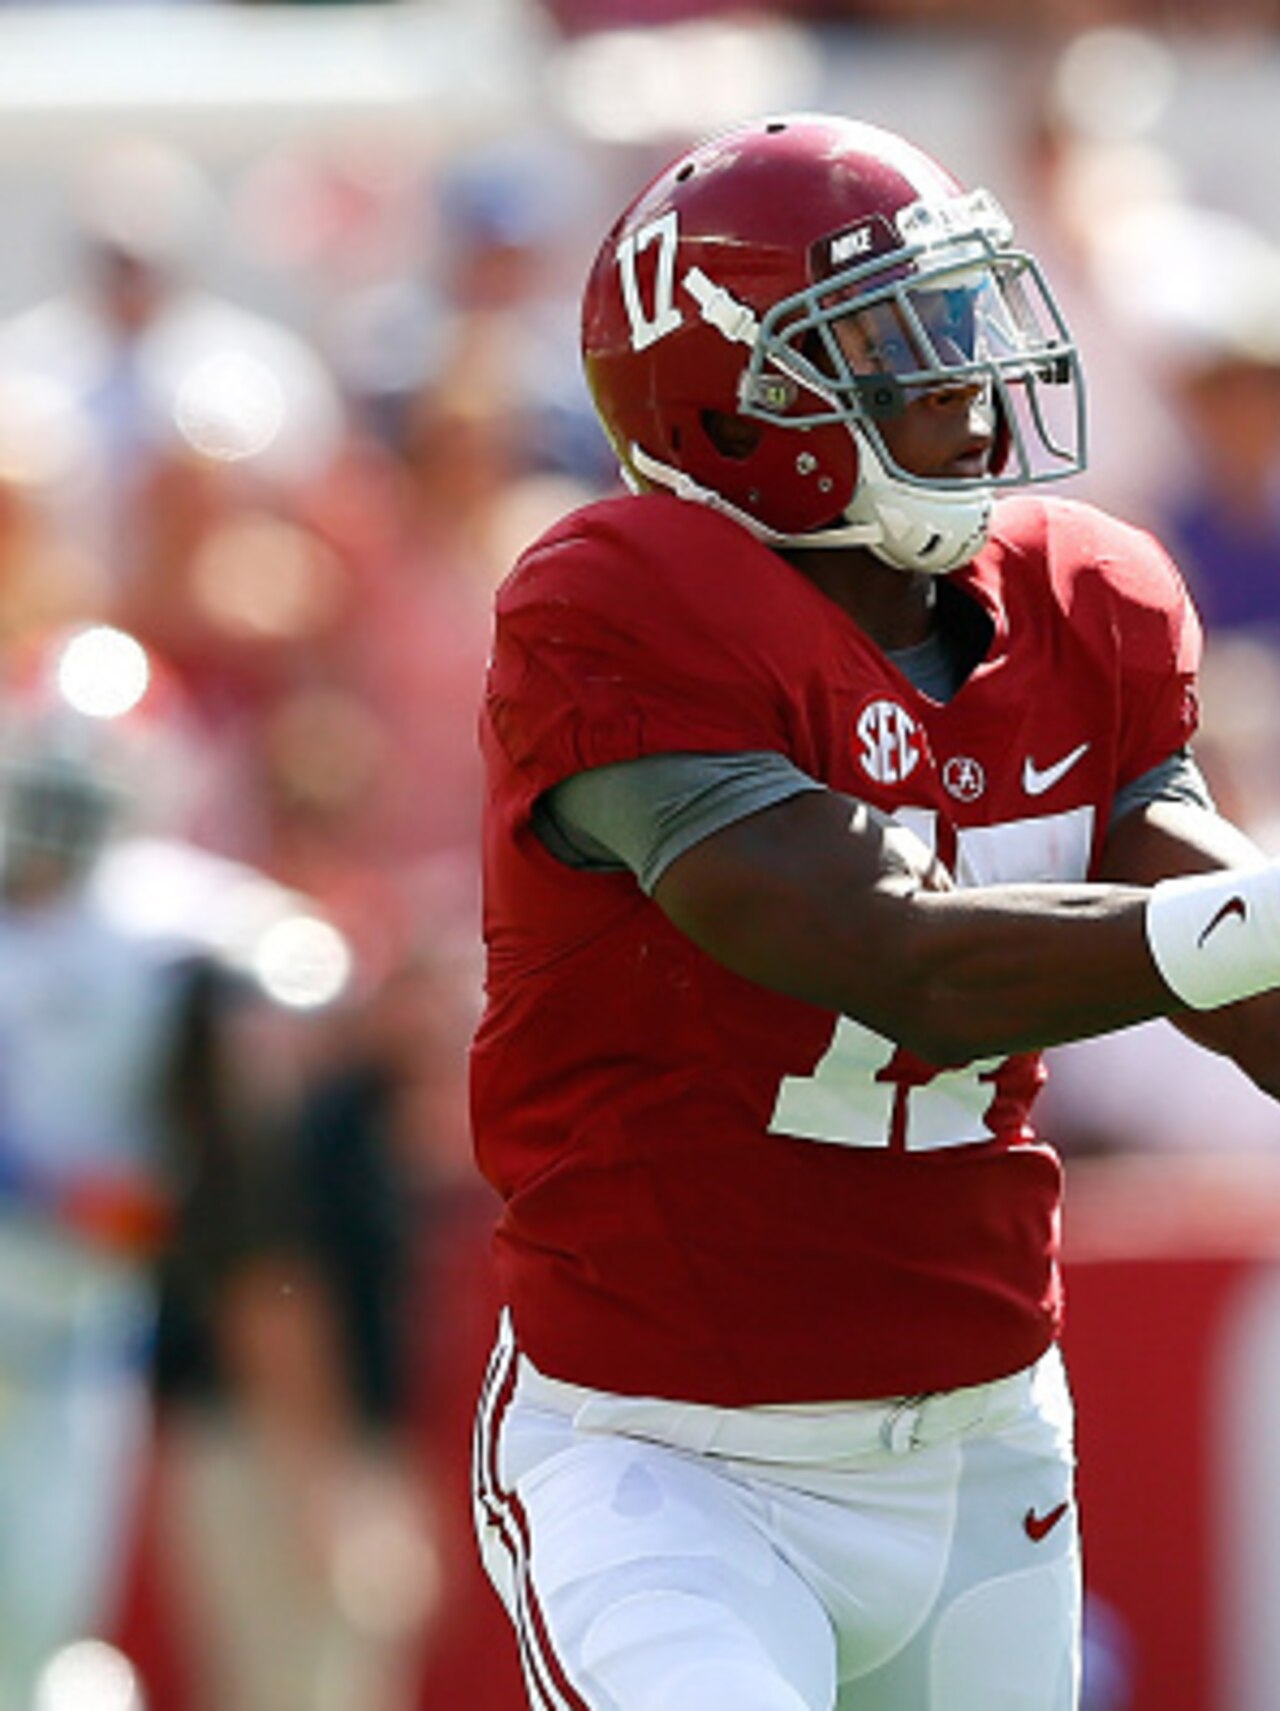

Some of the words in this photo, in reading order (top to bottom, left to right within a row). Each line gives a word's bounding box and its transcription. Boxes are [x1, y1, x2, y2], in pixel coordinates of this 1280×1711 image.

[616, 211, 682, 352] 17
[831, 226, 872, 264] NIKE
[857, 698, 919, 784] SEC
